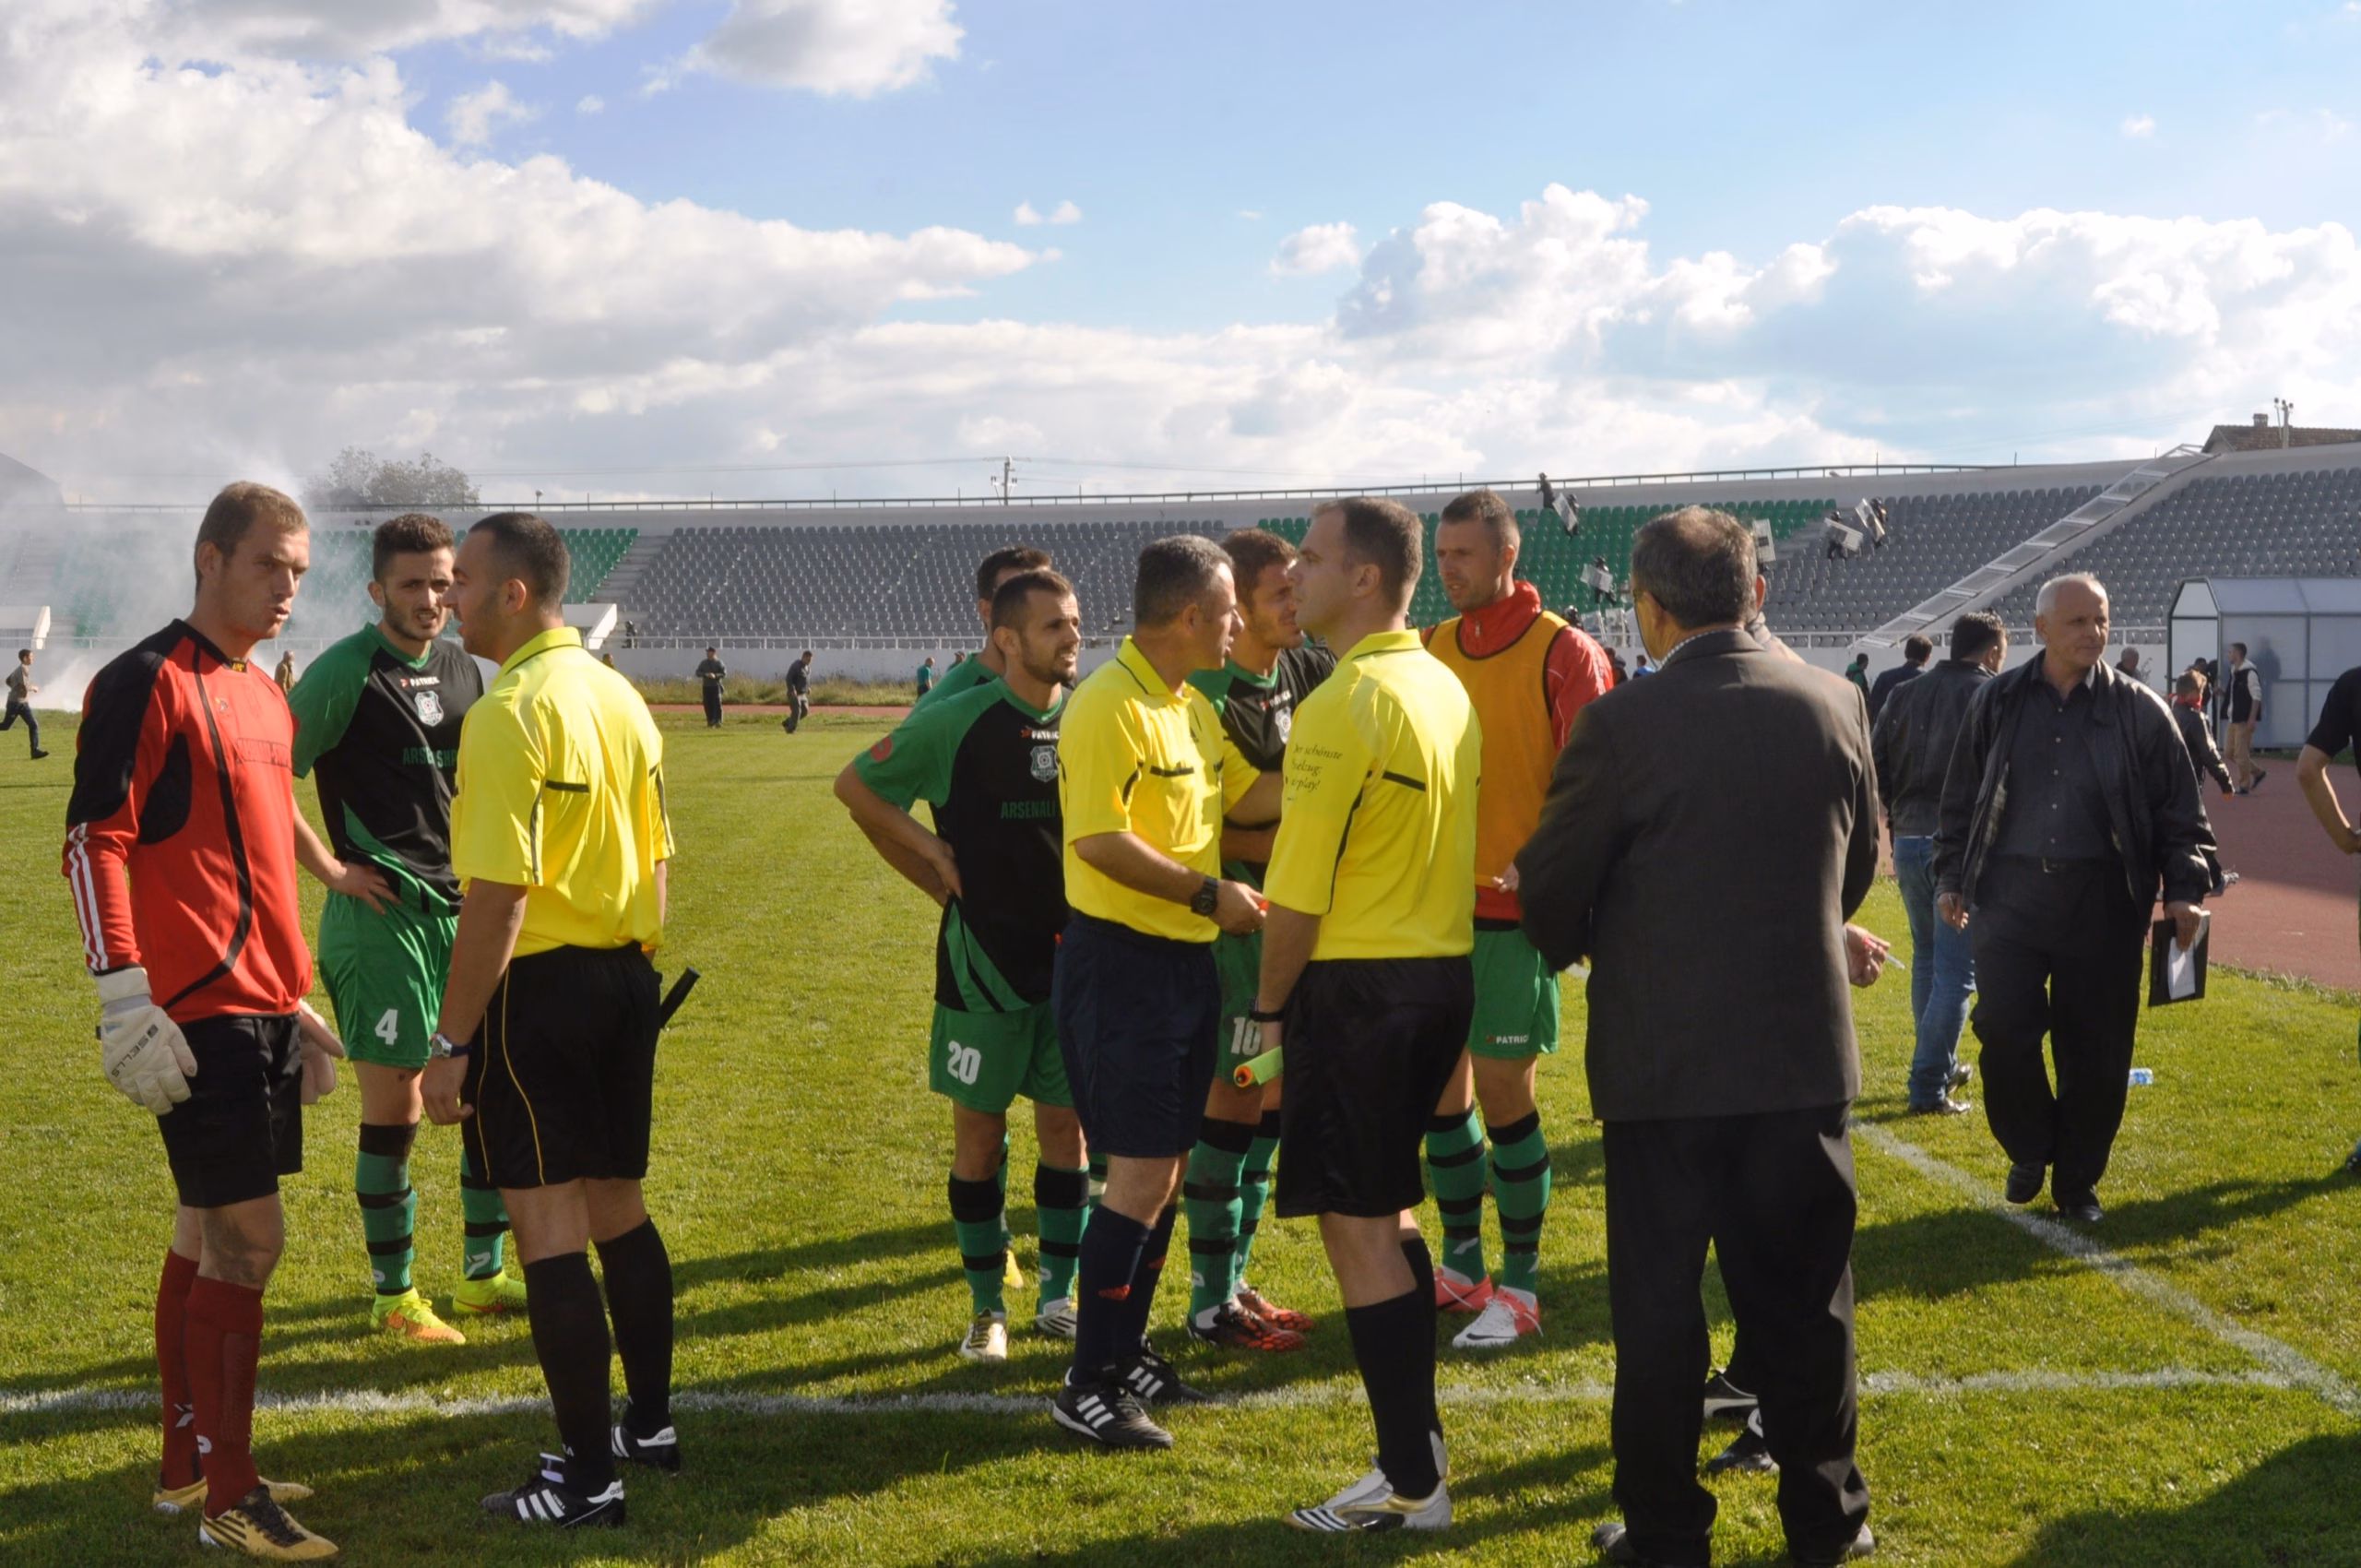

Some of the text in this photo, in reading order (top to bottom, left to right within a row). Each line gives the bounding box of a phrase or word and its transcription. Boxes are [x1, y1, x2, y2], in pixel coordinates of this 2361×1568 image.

[1031, 731, 1060, 740] PATRIC
[374, 1008, 398, 1046] 4
[1230, 1016, 1262, 1056] 10
[1496, 1034, 1529, 1044] PATRIC
[111, 1035, 148, 1077] SELLS
[947, 1040, 981, 1085] 20
